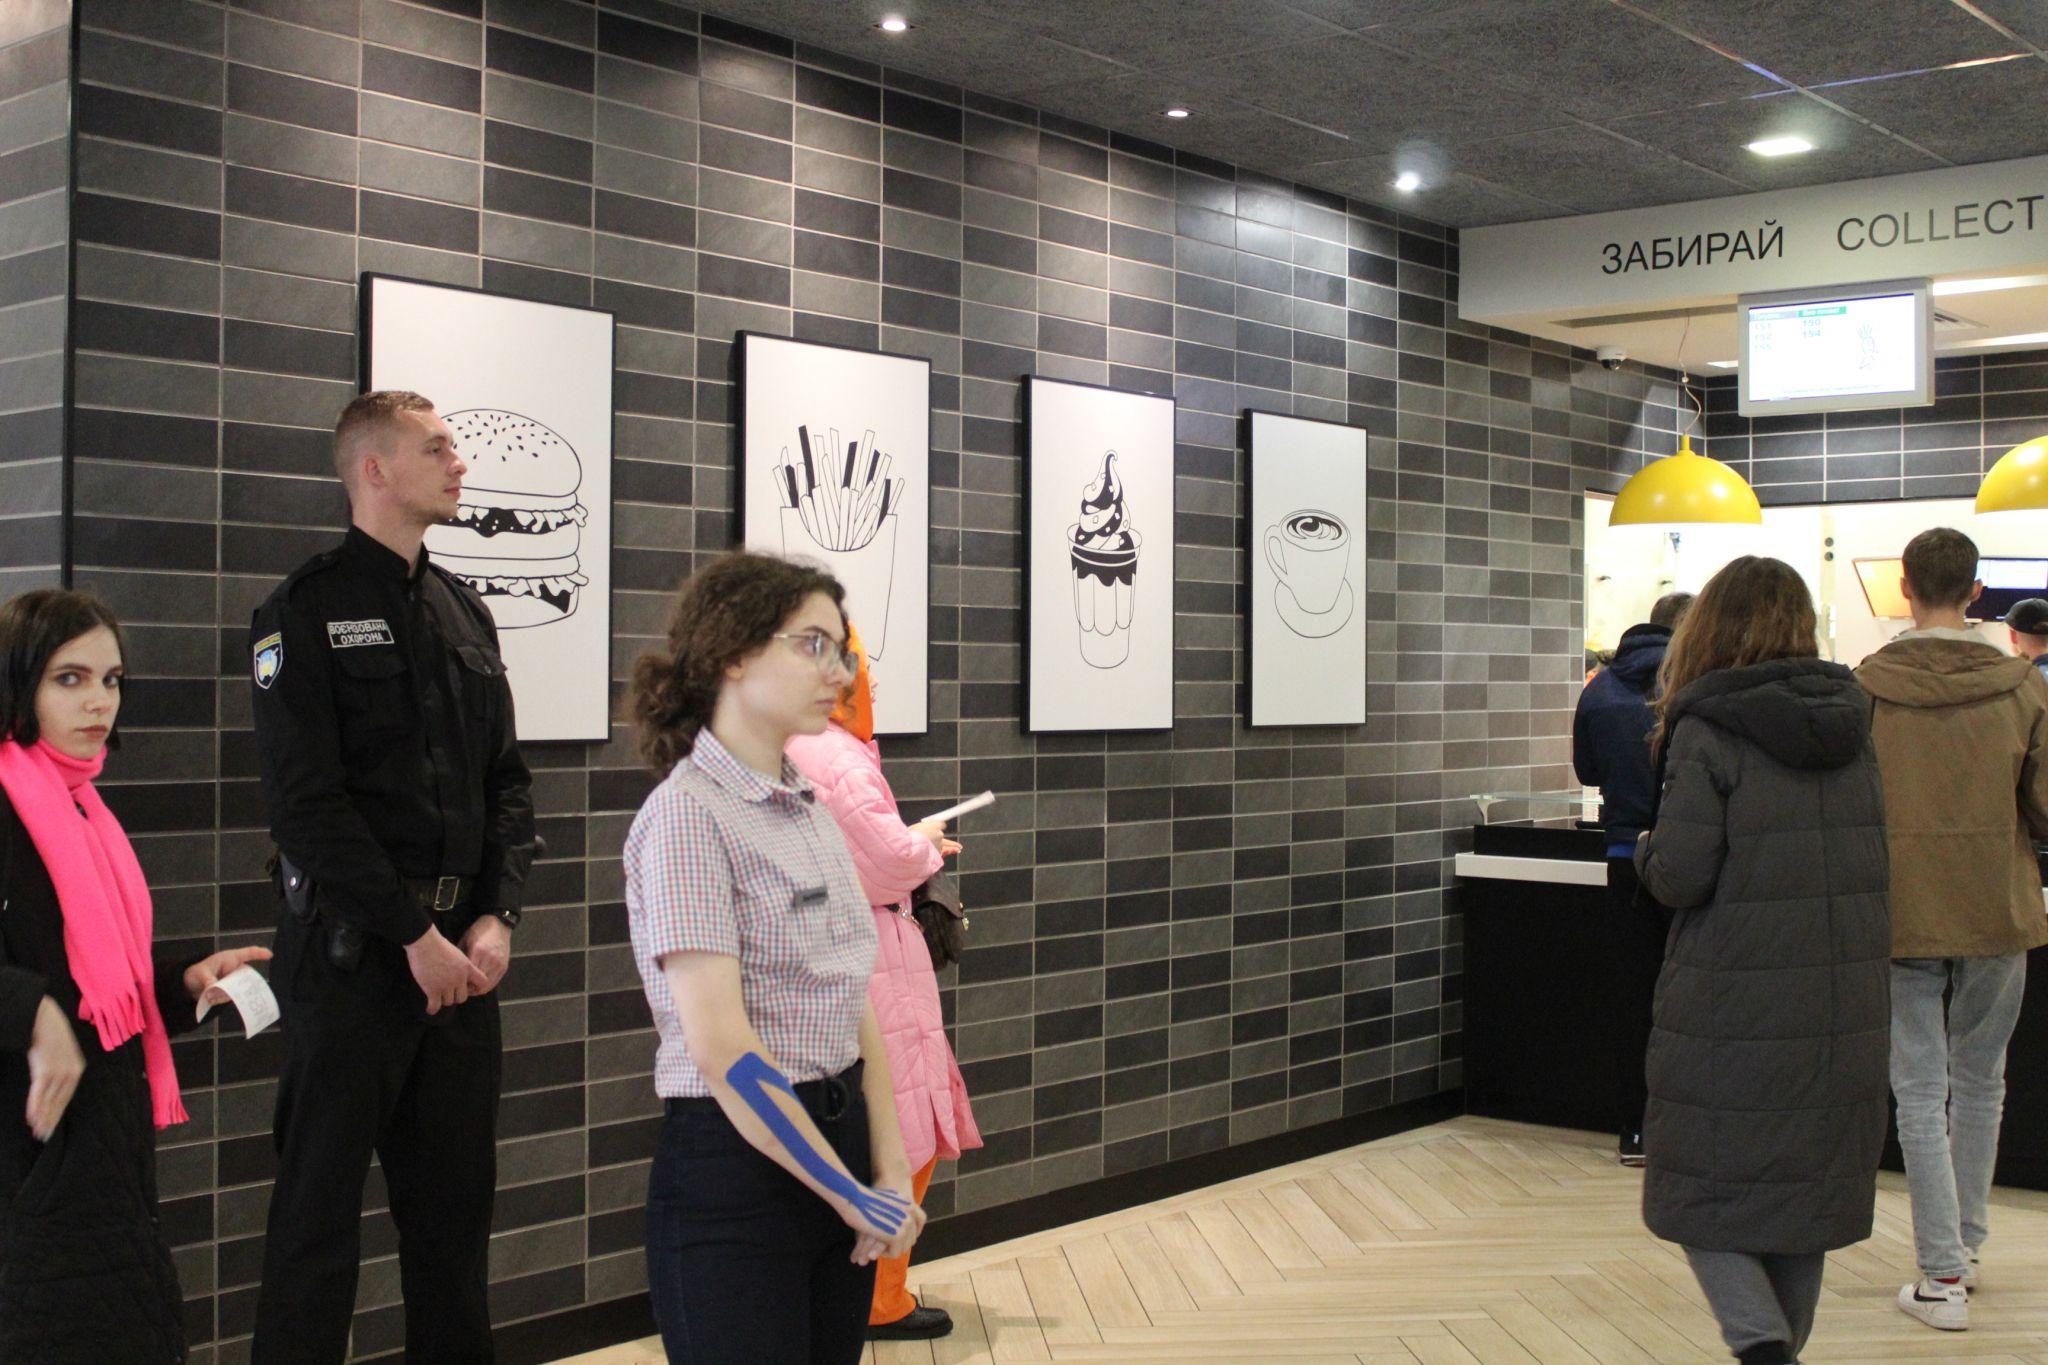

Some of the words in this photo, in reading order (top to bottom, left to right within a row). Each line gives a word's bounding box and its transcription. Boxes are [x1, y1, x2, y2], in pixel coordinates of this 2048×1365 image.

[1601, 217, 1784, 274] ЗАБИРАЙ
[1837, 195, 2045, 252] COLLECT
[340, 633, 384, 645] ОХОРОНА
